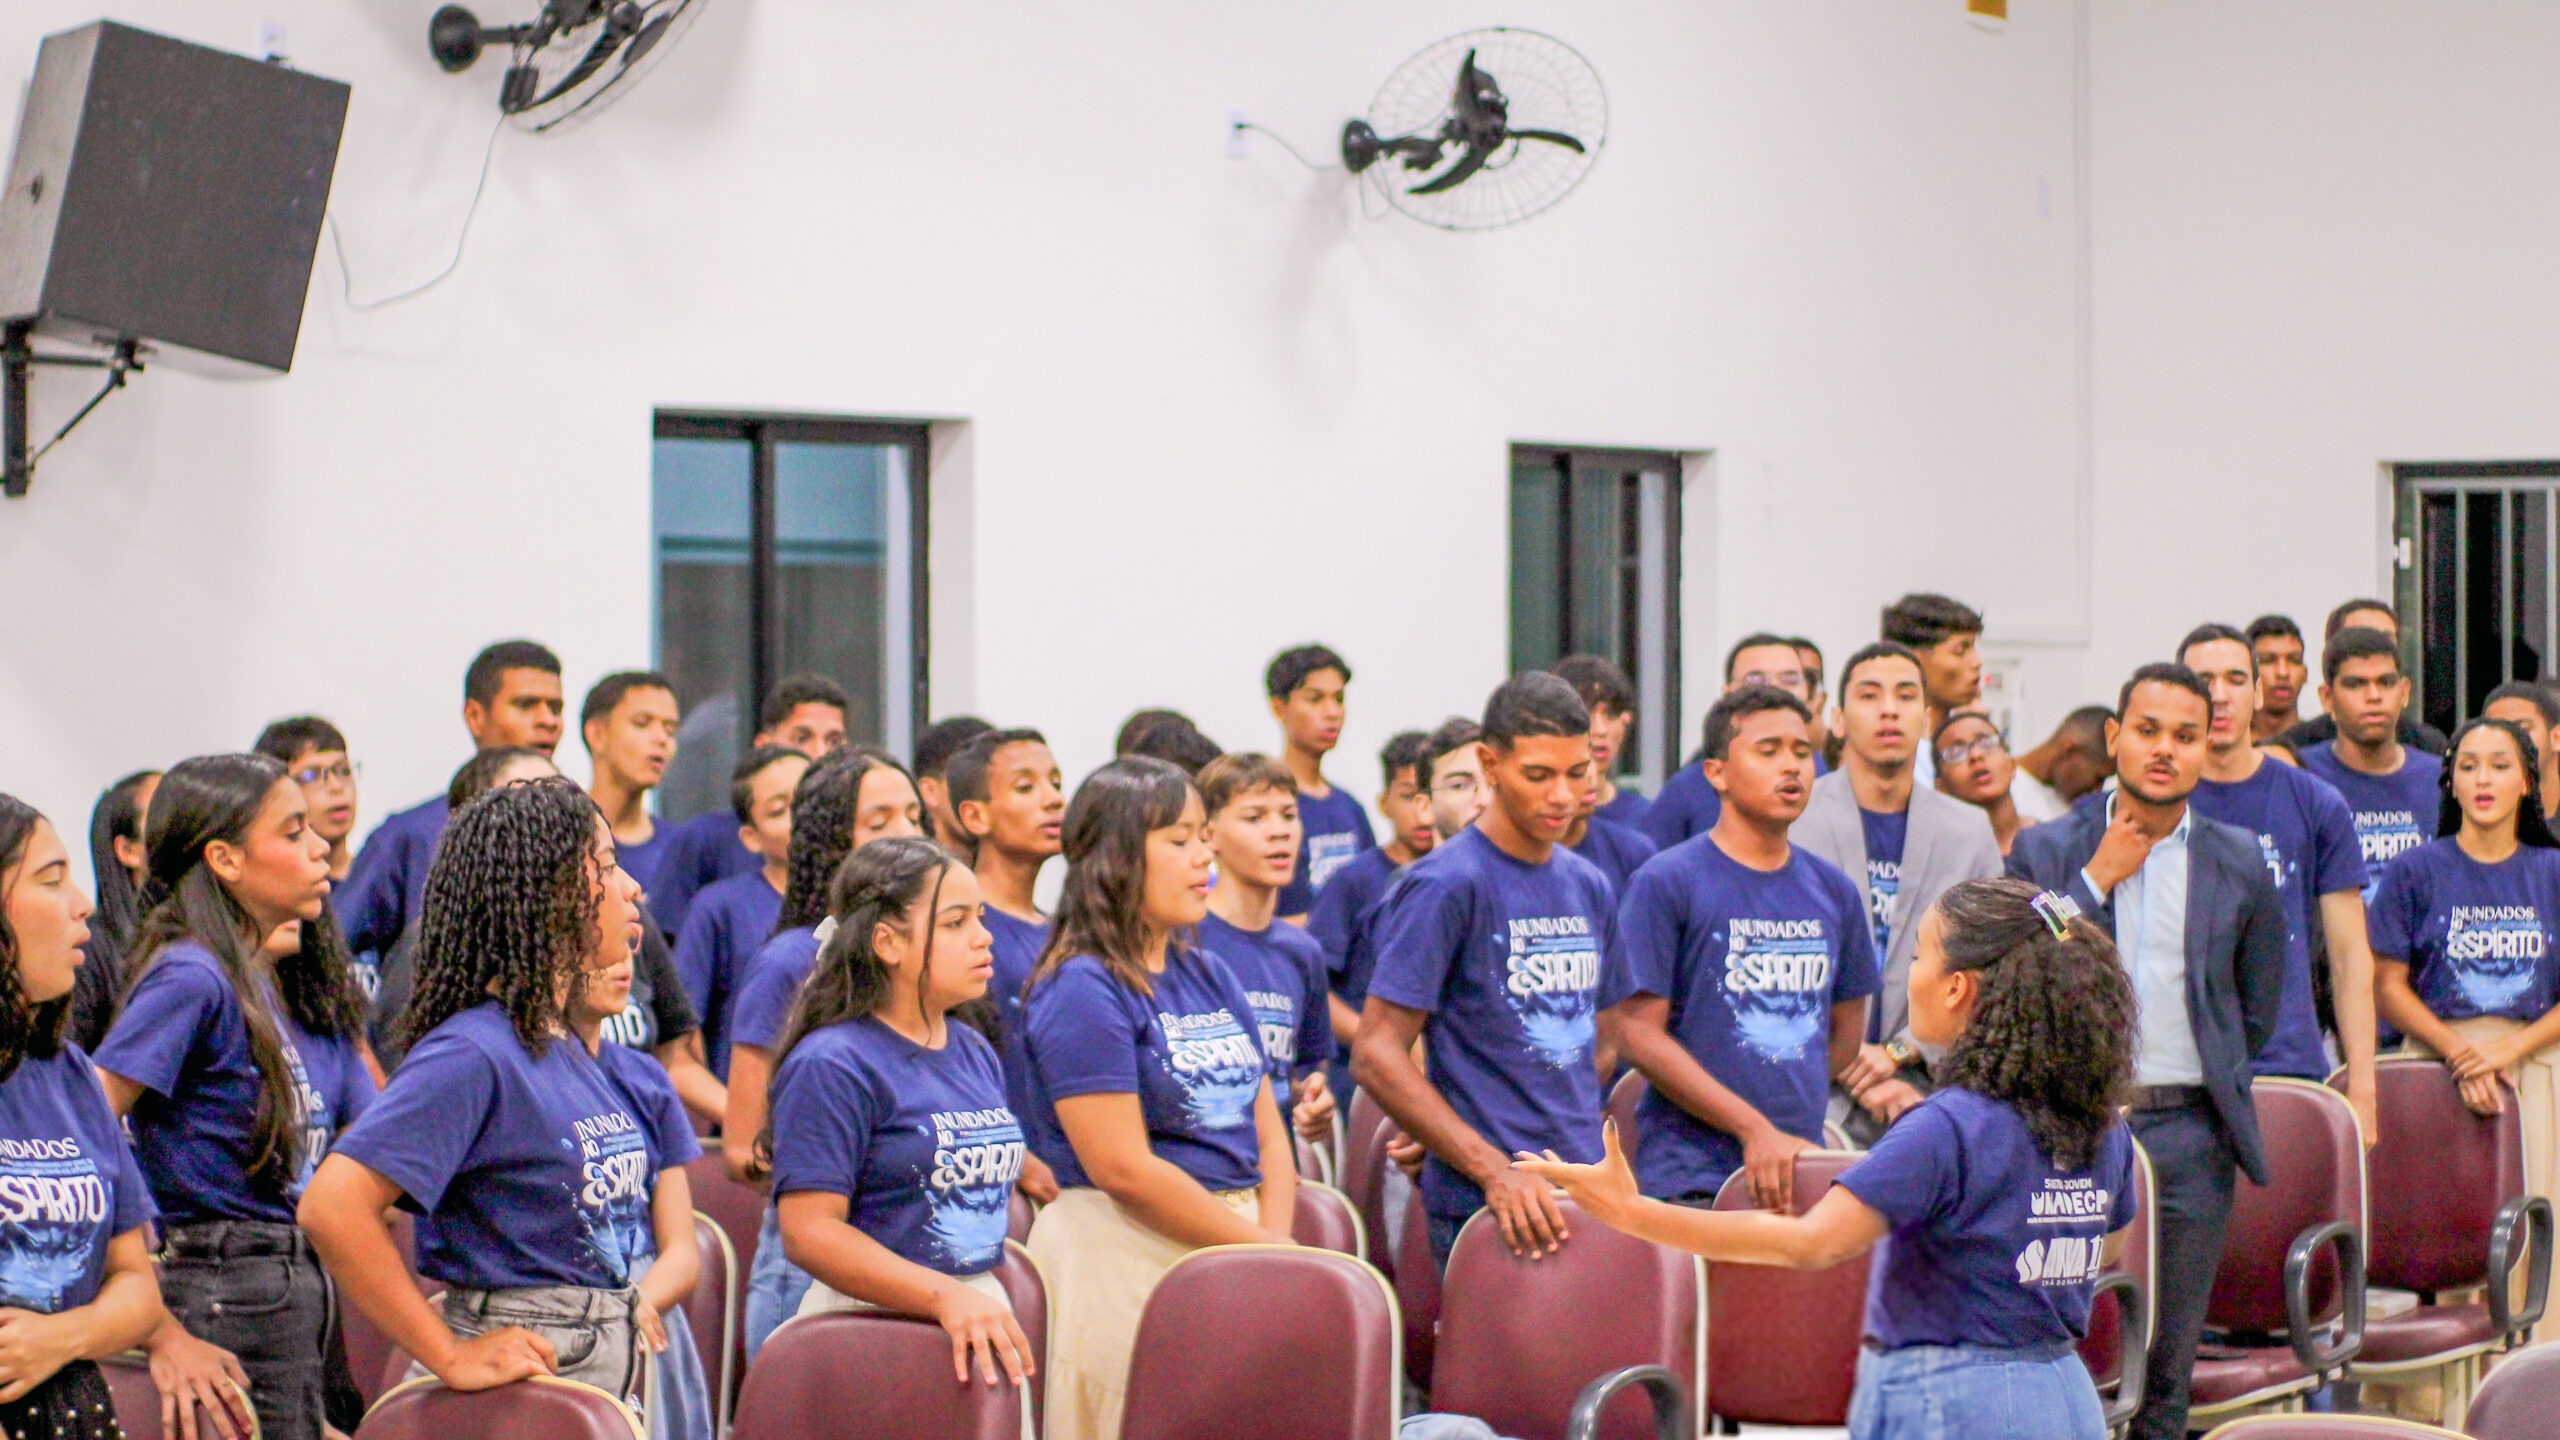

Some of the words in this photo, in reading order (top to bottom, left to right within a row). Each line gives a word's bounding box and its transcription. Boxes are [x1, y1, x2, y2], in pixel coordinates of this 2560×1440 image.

[2452, 905, 2535, 921] INUNDADOS
[1729, 918, 1822, 938] INUNDADOS
[936, 1129, 954, 1148] NO
[580, 1139, 601, 1160] NO
